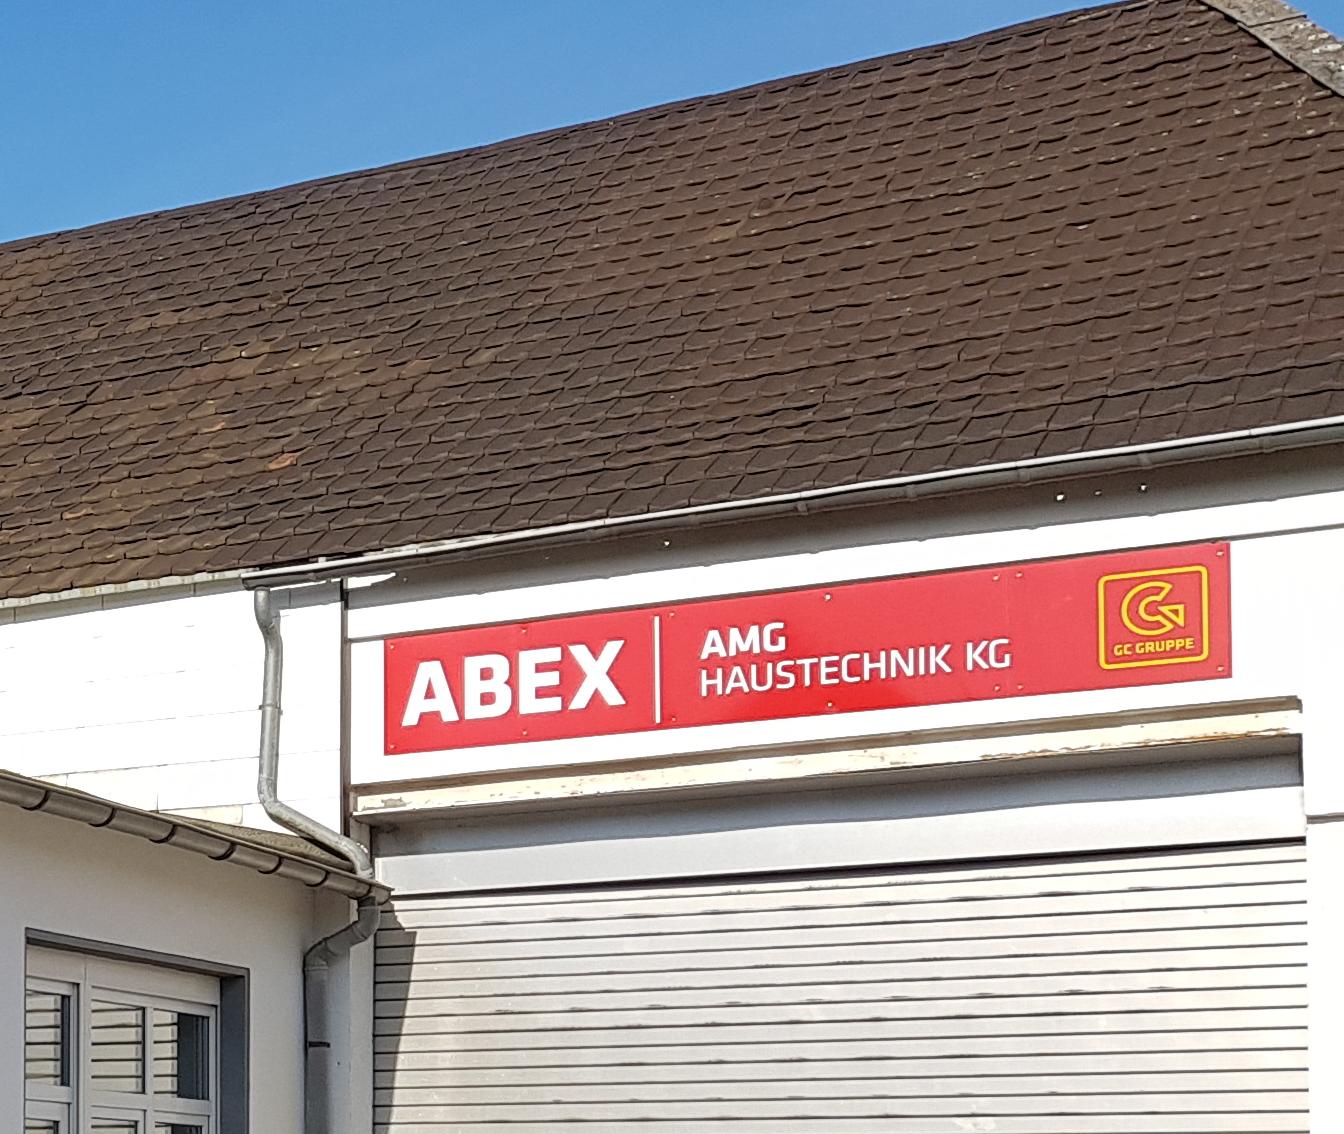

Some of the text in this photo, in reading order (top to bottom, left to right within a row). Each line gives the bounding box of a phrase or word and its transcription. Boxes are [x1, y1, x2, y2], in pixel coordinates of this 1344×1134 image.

[699, 621, 787, 660] AMG
[1113, 637, 1195, 657] GC GRUPPE
[400, 639, 627, 727] ABEX
[699, 638, 1011, 697] HAUSTECHNIK KG
